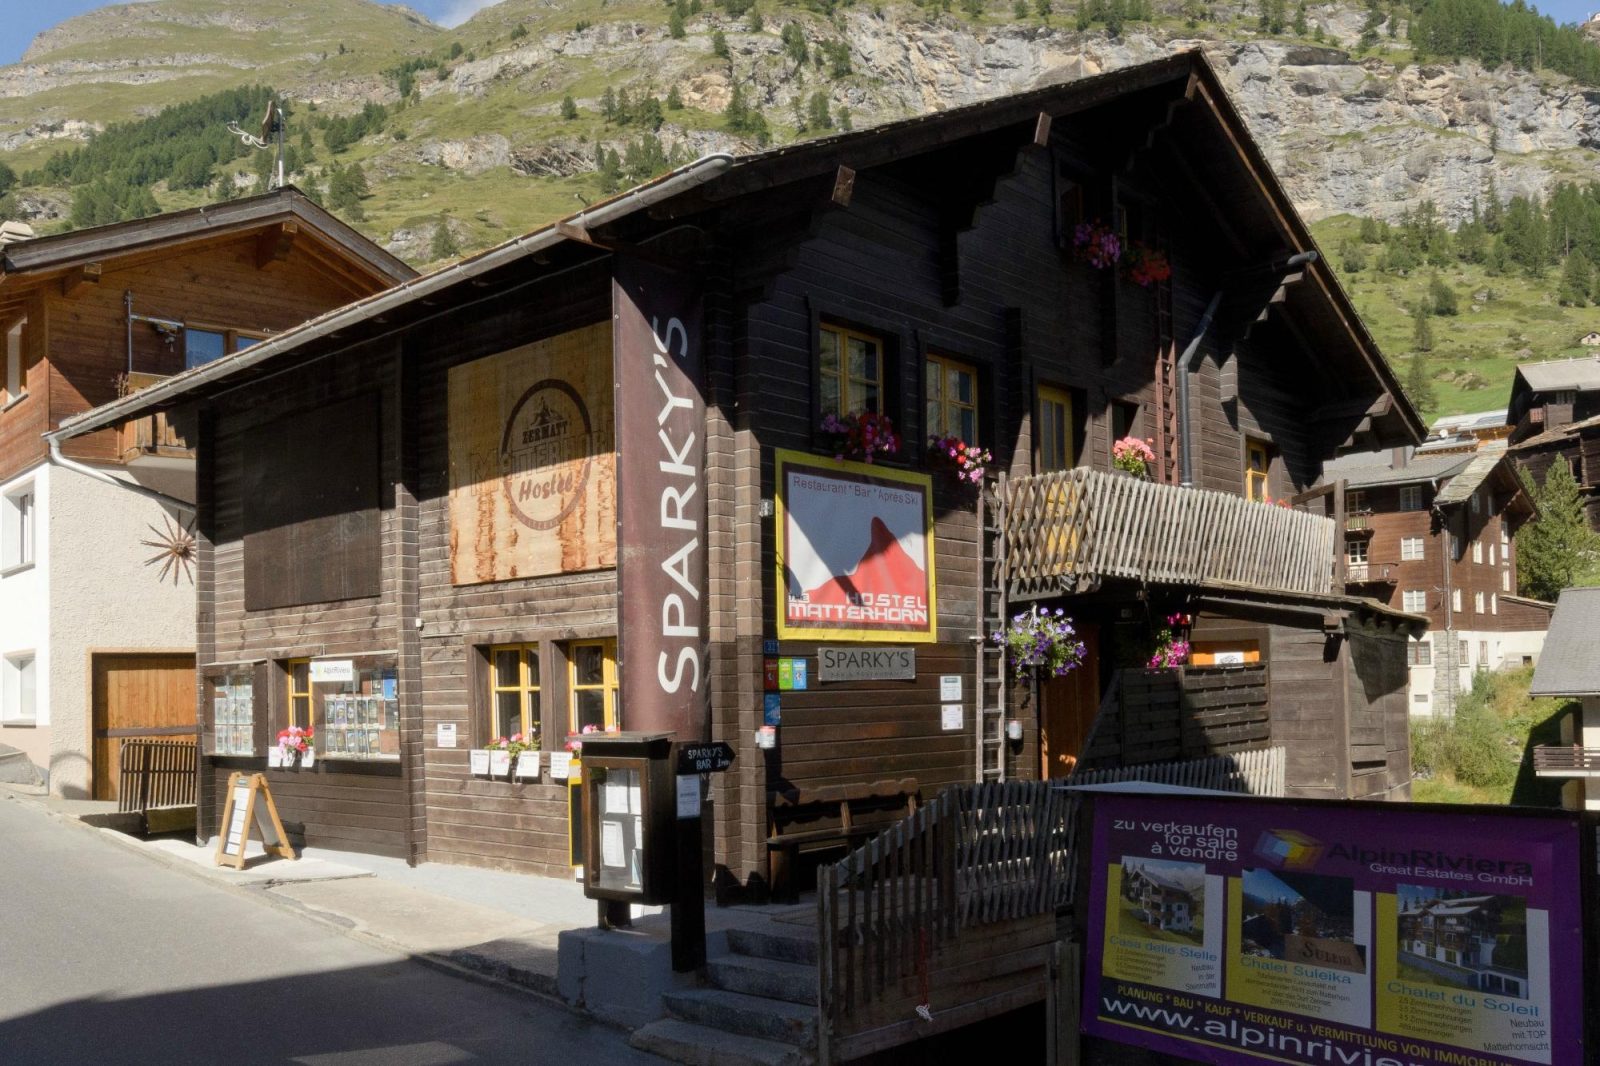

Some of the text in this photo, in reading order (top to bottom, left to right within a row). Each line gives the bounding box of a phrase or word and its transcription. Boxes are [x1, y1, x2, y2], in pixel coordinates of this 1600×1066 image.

[522, 421, 568, 444] ZERMATT
[519, 472, 573, 502] Hostel
[793, 476, 846, 495] Restaurant
[854, 485, 870, 498] Bar
[652, 316, 701, 694] SPARKY'S
[846, 592, 927, 609] HOSTEL
[788, 602, 928, 622] MATTERHORN
[824, 649, 910, 669] SPARKY'S
[696, 759, 712, 771] BAR
[1113, 819, 1239, 839] zu verkaufen
[1163, 832, 1239, 850] for sale
[1150, 842, 1239, 861] à vendre
[1326, 842, 1533, 876] AlpinRiviera
[1369, 863, 1534, 887] Great Estates GmbH
[1180, 946, 1218, 962] Stelle
[1240, 956, 1288, 973] Chalet
[1293, 965, 1352, 985] Suleika
[1387, 980, 1540, 1017] Chalet du Soleil
[1117, 985, 1164, 1004] PLANUNG
[1172, 996, 1195, 1010] BAU
[1204, 1003, 1232, 1018] KAUF
[1243, 1010, 1294, 1031] VERKAUF
[1296, 1023, 1308, 1034] u.
[1310, 1023, 1398, 1053] VERMITTLUNG
[1400, 1042, 1431, 1059] VON
[1510, 1018, 1545, 1028] Neubau
[1511, 1030, 1547, 1039] mit TOP
